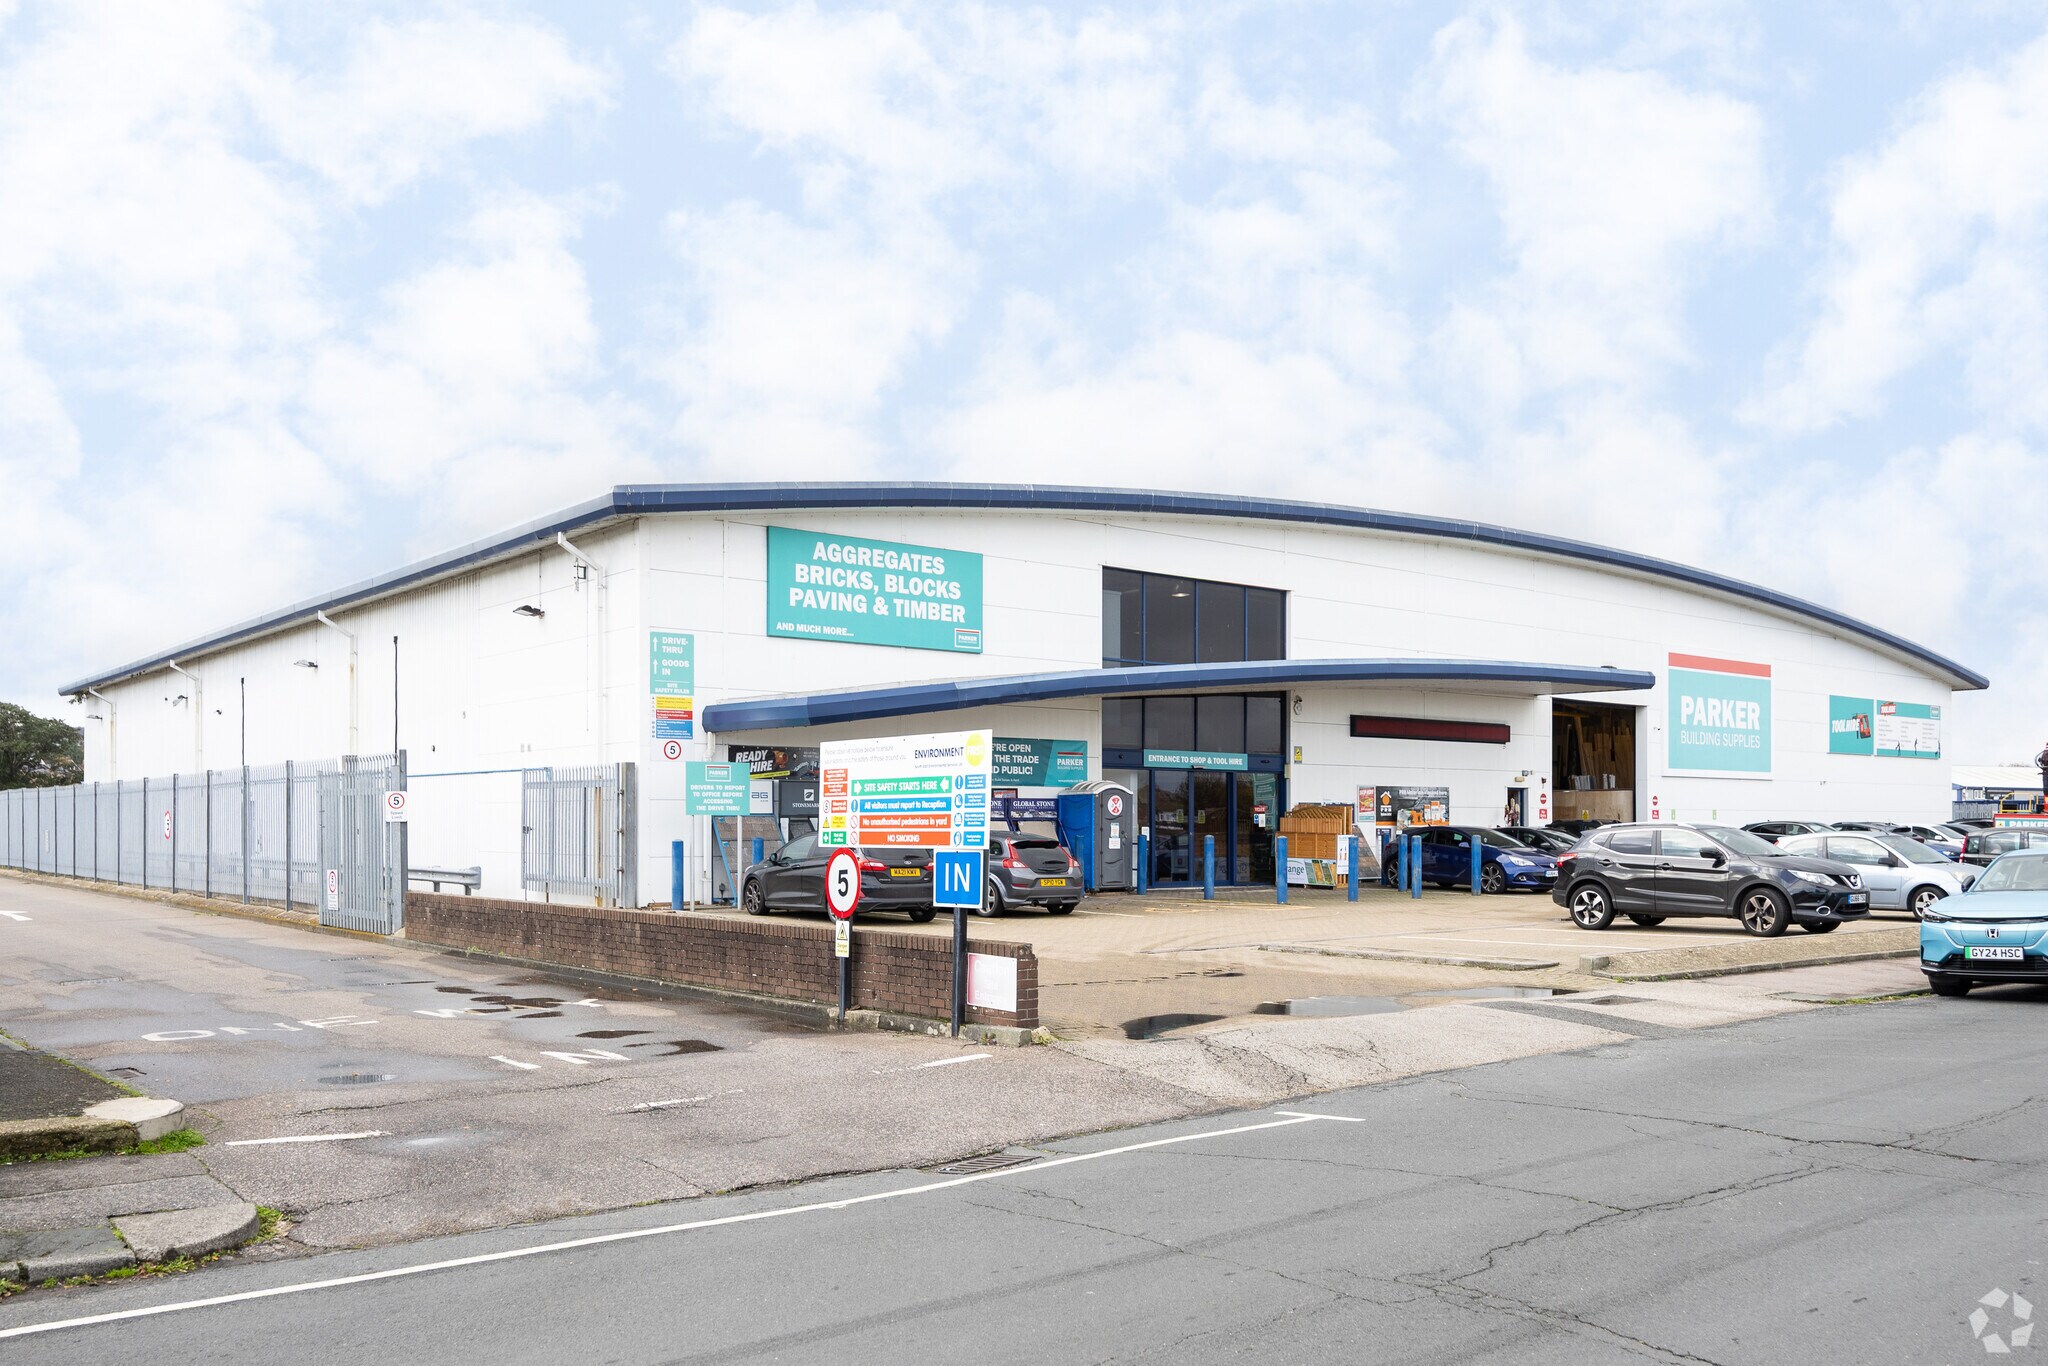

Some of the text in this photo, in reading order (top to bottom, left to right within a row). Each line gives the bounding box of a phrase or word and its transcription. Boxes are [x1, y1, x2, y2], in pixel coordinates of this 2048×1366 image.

[813, 541, 945, 575] AGGREGATES
[795, 563, 961, 600] BRICKS, BLOCKS
[789, 587, 966, 623] PAVING & TIMBER
[776, 622, 854, 636] AND MUCH MORE...
[662, 636, 689, 646] DRIVE-
[662, 646, 683, 654] THRU
[662, 659, 690, 668] GOODS
[662, 668, 671, 676] IN
[1681, 695, 1761, 731] PARKER
[1832, 719, 1846, 733] TOOL
[1681, 730, 1761, 749] BUILDING SUPPLIES
[670, 746, 676, 755] 5
[915, 747, 964, 759] ENVIRONMENT
[1008, 744, 1031, 752] OPEN
[735, 749, 768, 763] READY
[994, 754, 1039, 764] THE TRADE
[1148, 754, 1180, 763] ENTRANCE
[1190, 756, 1206, 764] SHOP
[1213, 757, 1228, 765] TOOL
[750, 759, 774, 773] HIRE
[1057, 758, 1084, 766] PARKER
[1001, 766, 1033, 775] PUBLIC!
[864, 780, 938, 792] SITE SAFETY STARTS HERE
[393, 797, 400, 805] 5
[900, 801, 915, 810] report
[921, 801, 946, 810] Reception
[862, 817, 948, 827] No unauthorised pedestrians in yard
[896, 834, 920, 842] SMOKING
[1287, 866, 1305, 875] ange
[945, 862, 970, 892] IN
[837, 869, 849, 897] 5
[1971, 948, 2021, 958] GY24 HSC
[141, 998, 604, 1042] ONE WAY
[489, 1048, 632, 1070] IN
